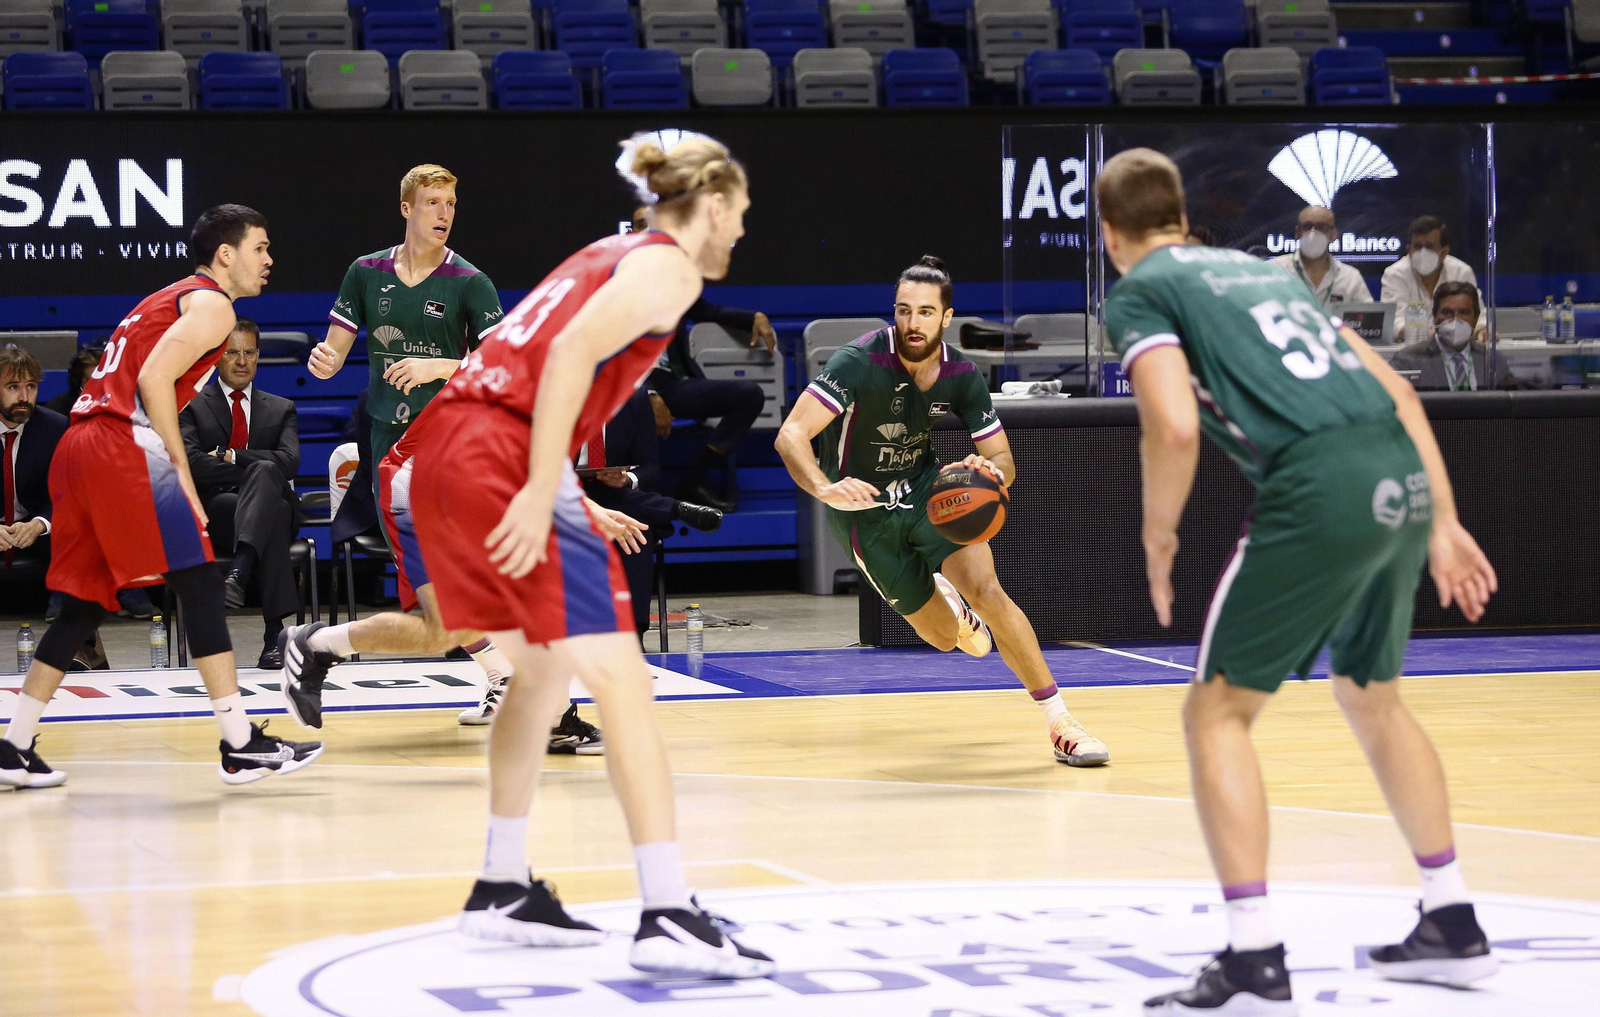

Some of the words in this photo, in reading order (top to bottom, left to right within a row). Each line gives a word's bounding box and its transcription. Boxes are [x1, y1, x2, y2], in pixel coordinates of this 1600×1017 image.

[0, 158, 184, 228] SAN
[119, 241, 188, 260] VIVIR
[1342, 232, 1400, 252] Banco
[402, 341, 443, 358] Unicaja
[1248, 299, 1363, 380] 52
